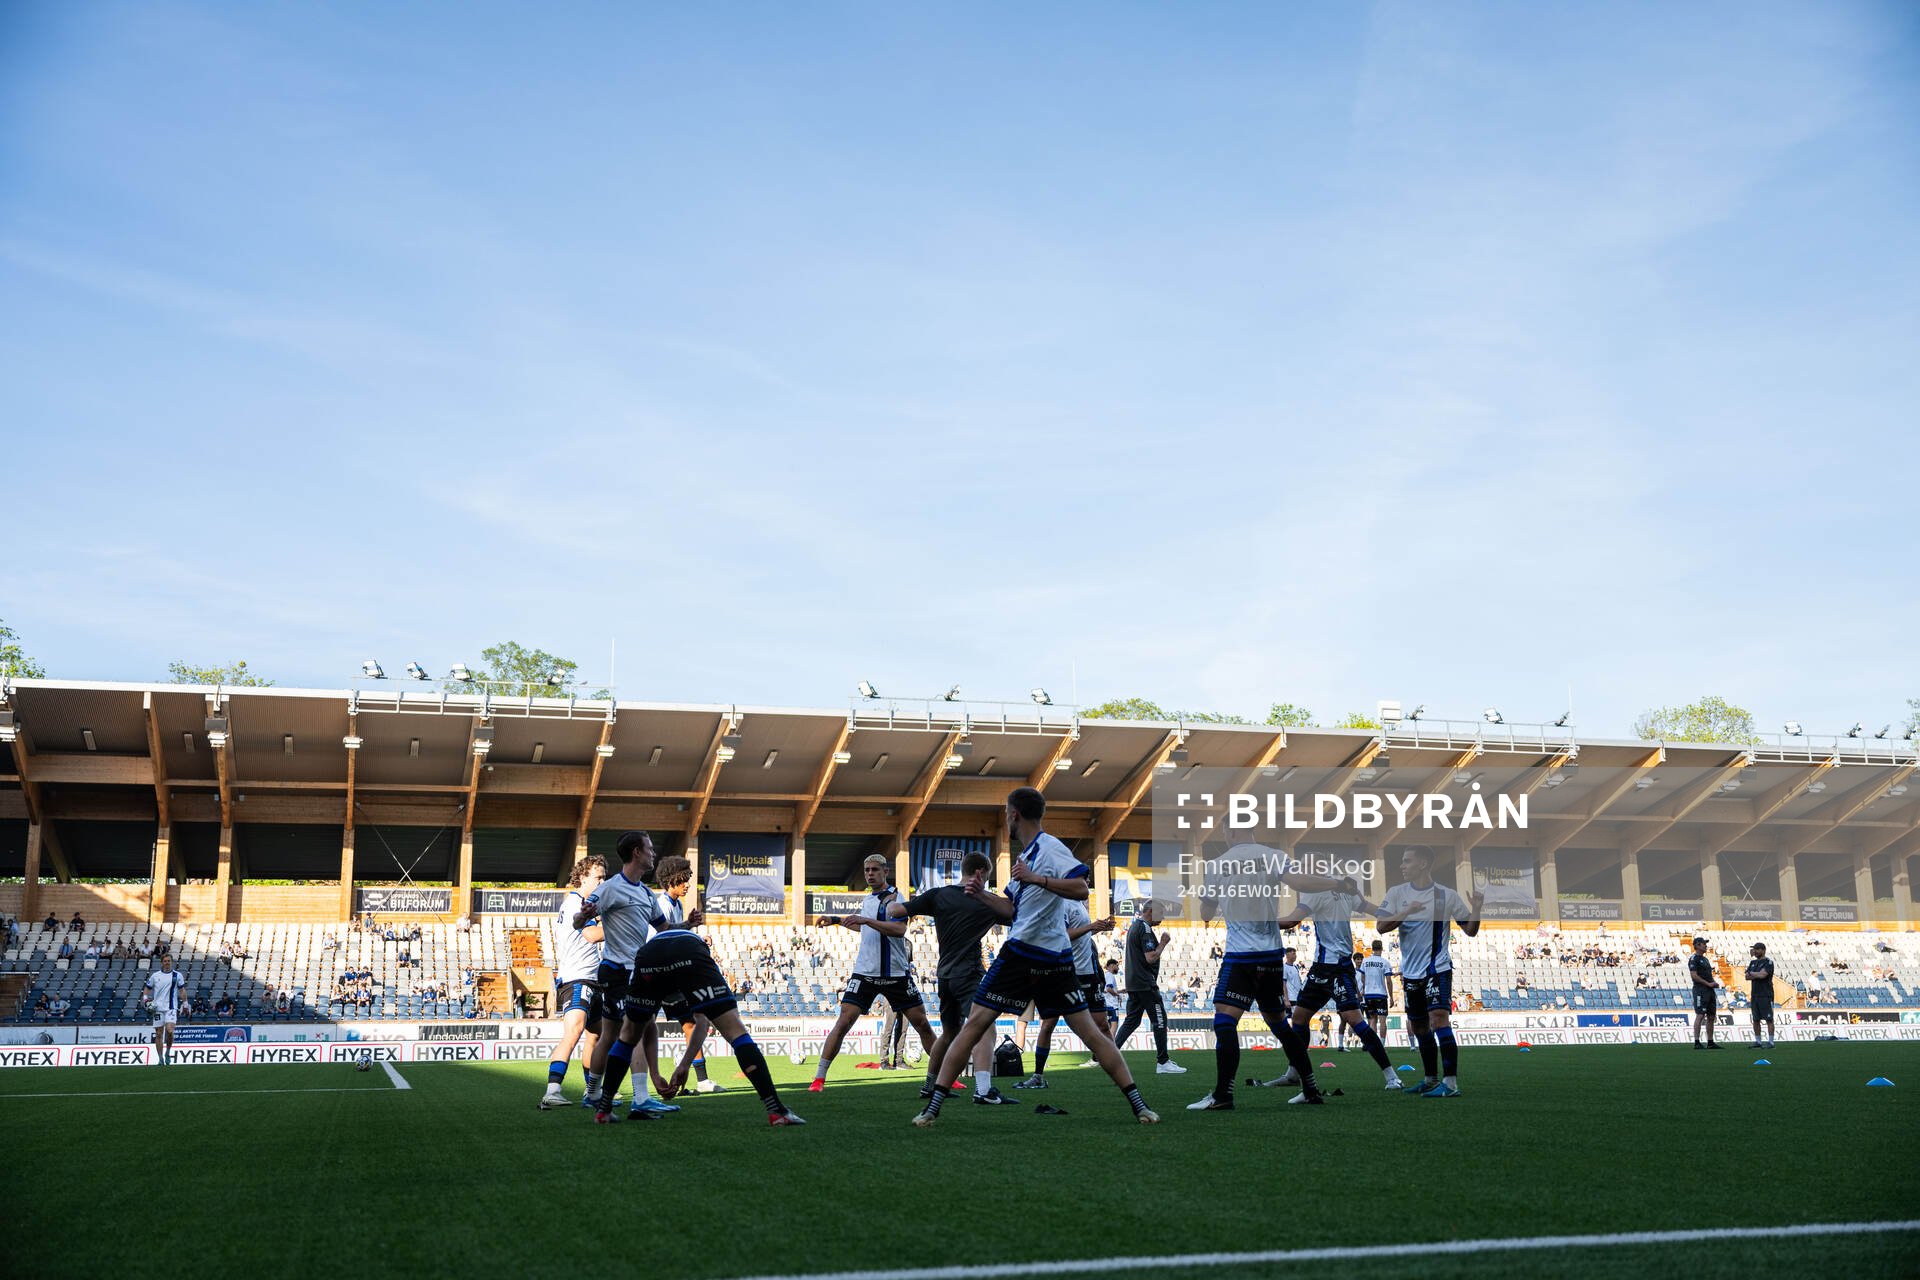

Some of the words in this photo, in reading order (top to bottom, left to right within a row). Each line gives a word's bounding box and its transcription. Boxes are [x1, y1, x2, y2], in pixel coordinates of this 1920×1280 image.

[937, 850, 962, 859] SIRIUS
[733, 855, 773, 866] Uppsala
[733, 866, 777, 876] kommun
[1490, 868, 1523, 877] Uppsala
[390, 900, 444, 908] BILFORUM
[511, 898, 524, 906] Nu
[526, 898, 541, 906] kör
[543, 898, 551, 906] vi
[832, 901, 845, 909] Nu
[729, 903, 779, 911] BILFORUM
[1580, 909, 1618, 917] BILFORUM
[1459, 1034, 1505, 1045] HYREX
[1519, 1033, 1563, 1044] HYREX
[1576, 1032, 1620, 1043] HYREX
[1633, 1032, 1677, 1043] HYREX
[1847, 1029, 1888, 1039] HYREX
[0, 1052, 55, 1066] YREX
[75, 1051, 144, 1065] HYREX
[252, 1049, 317, 1062] HYREX
[417, 1047, 480, 1061] HYREX
